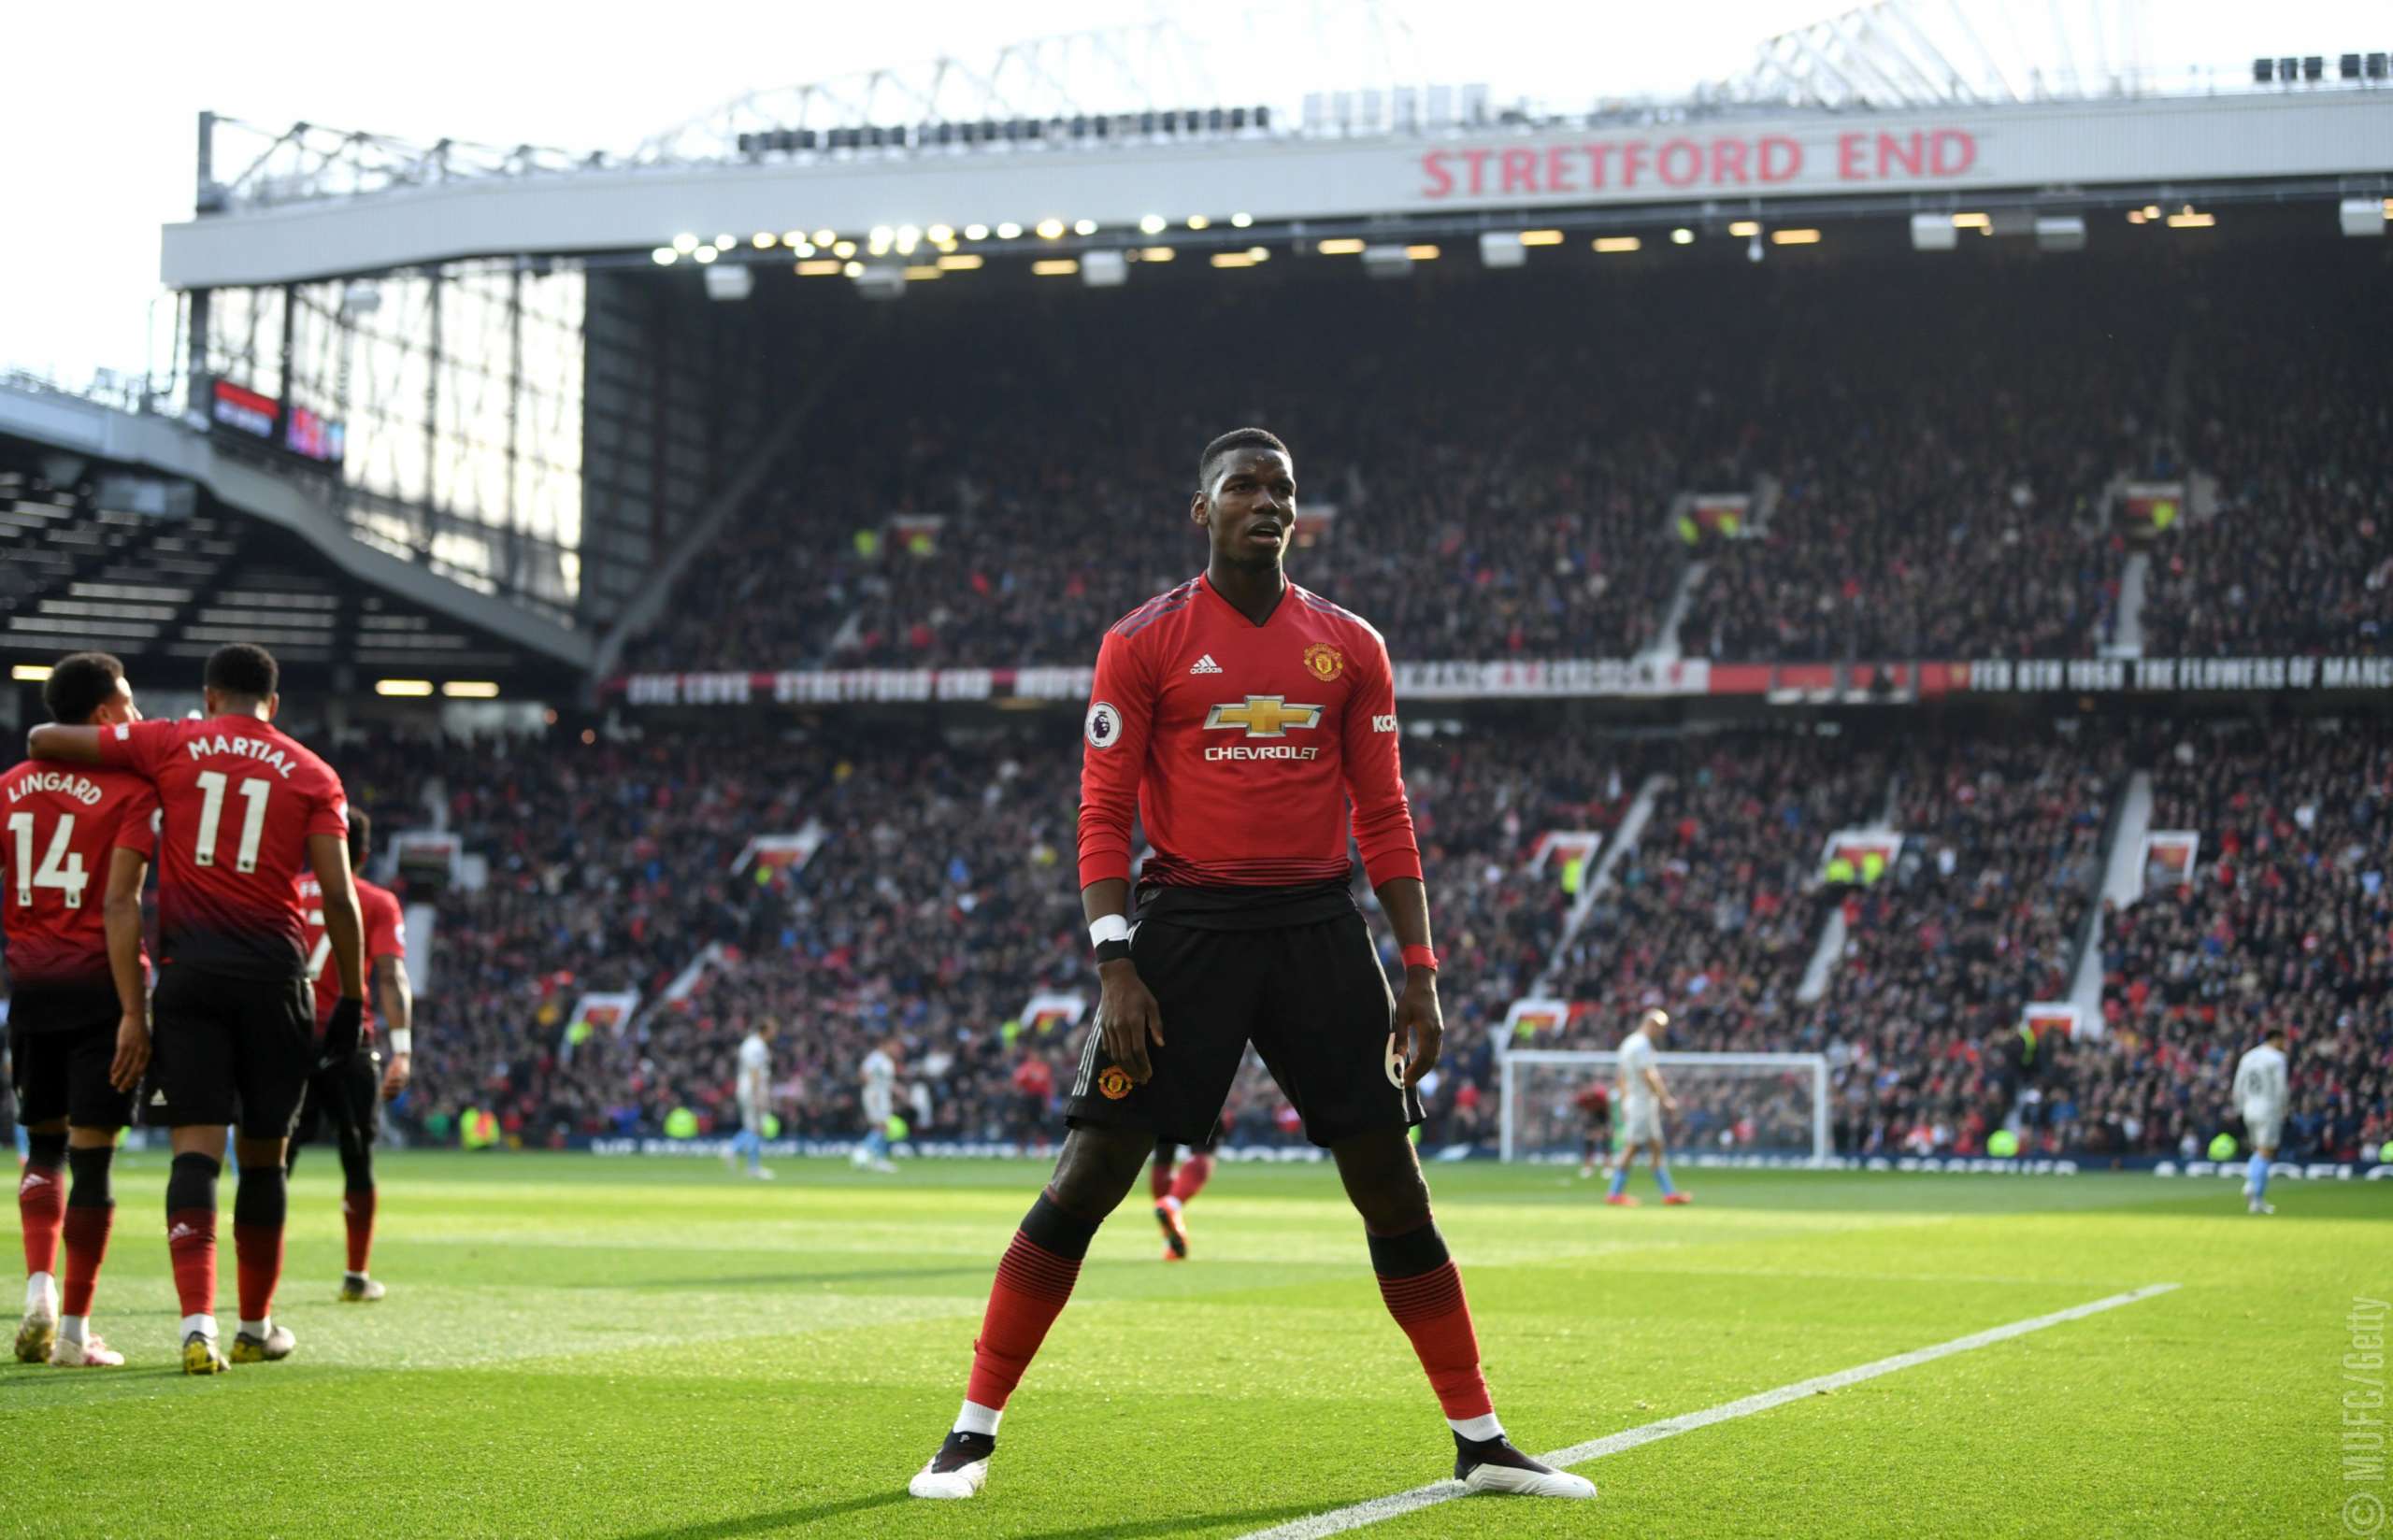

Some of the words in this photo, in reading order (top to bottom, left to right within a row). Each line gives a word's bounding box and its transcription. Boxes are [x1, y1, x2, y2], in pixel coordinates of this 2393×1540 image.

[1421, 134, 1803, 199] STRETFORD
[1838, 127, 1979, 180] END
[188, 734, 297, 780] MARTIAL
[1204, 746, 1319, 761] CHEVROLET
[7, 772, 103, 806] LINGARD
[194, 770, 271, 874] 11
[7, 811, 90, 908] 14
